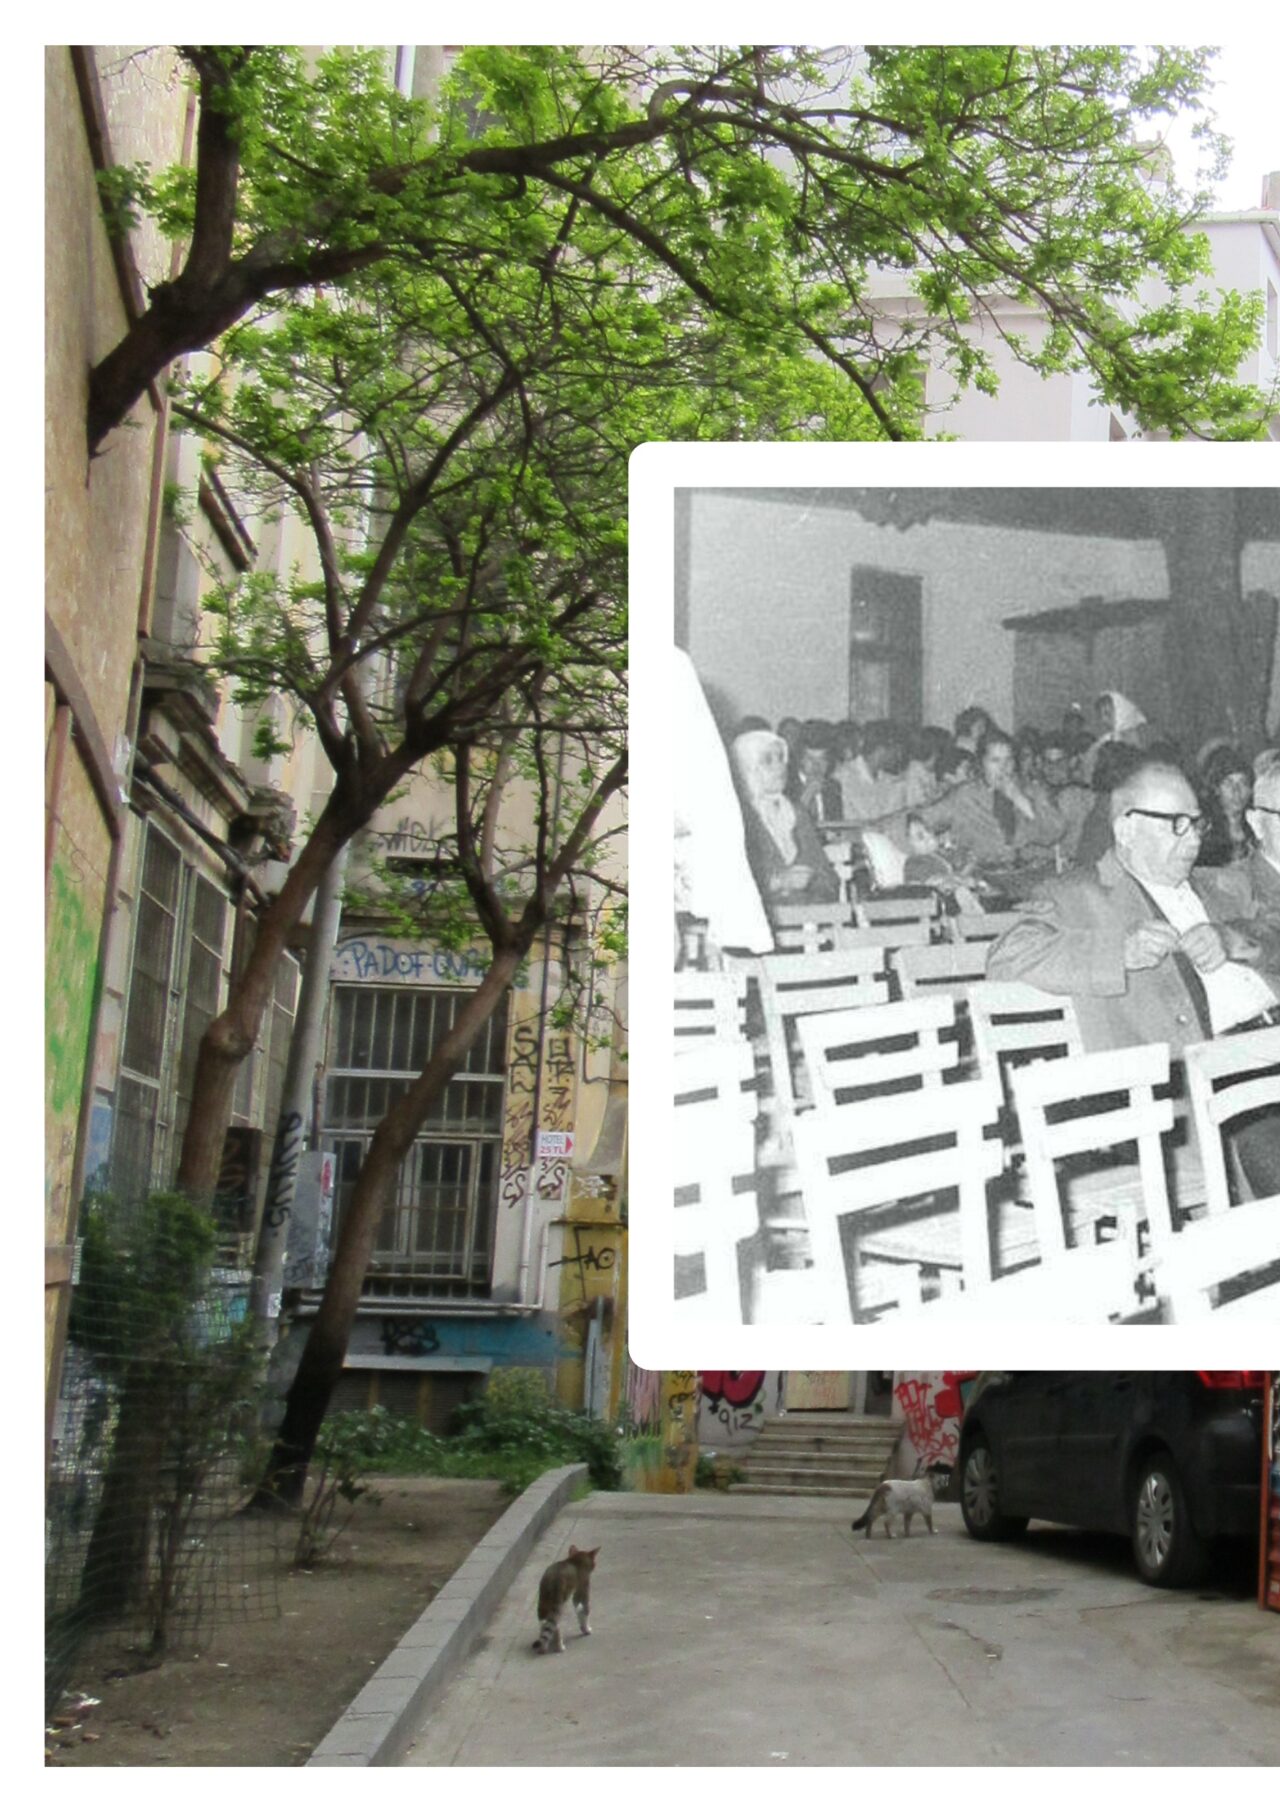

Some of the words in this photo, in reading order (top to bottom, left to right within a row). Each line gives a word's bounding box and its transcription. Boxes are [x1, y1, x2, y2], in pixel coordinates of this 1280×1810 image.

[541, 1134, 564, 1146] HOTEL
[540, 1145, 551, 1154] 25
[553, 1145, 565, 1154] TL
